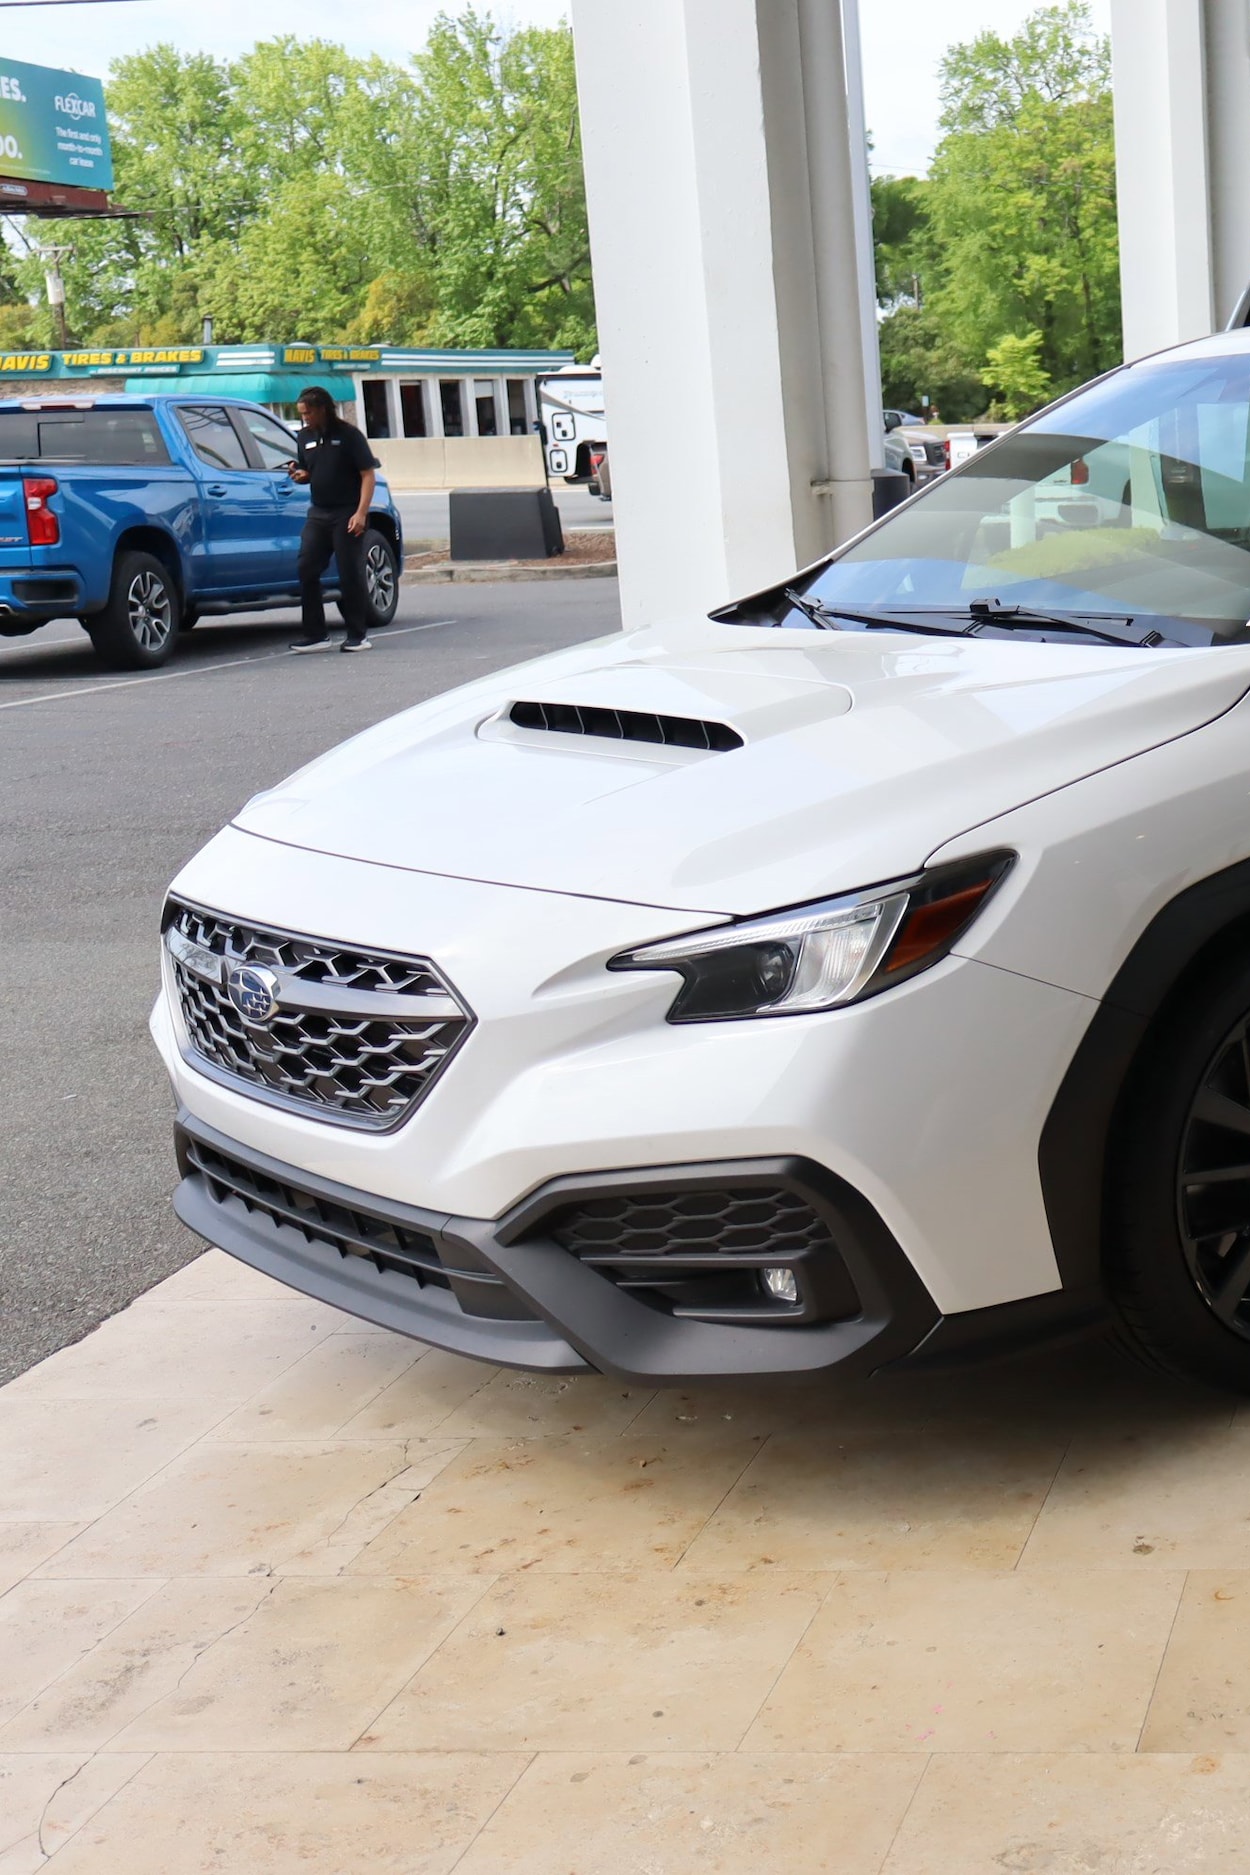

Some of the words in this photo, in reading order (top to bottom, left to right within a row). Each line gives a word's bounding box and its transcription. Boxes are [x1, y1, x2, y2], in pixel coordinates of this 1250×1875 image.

[0, 76, 26, 102] ES.
[54, 95, 96, 118] FLEXCAR
[0, 354, 50, 370] AVIS
[62, 353, 113, 365] TIRES
[116, 354, 126, 364] &
[130, 350, 203, 364] BRAKES
